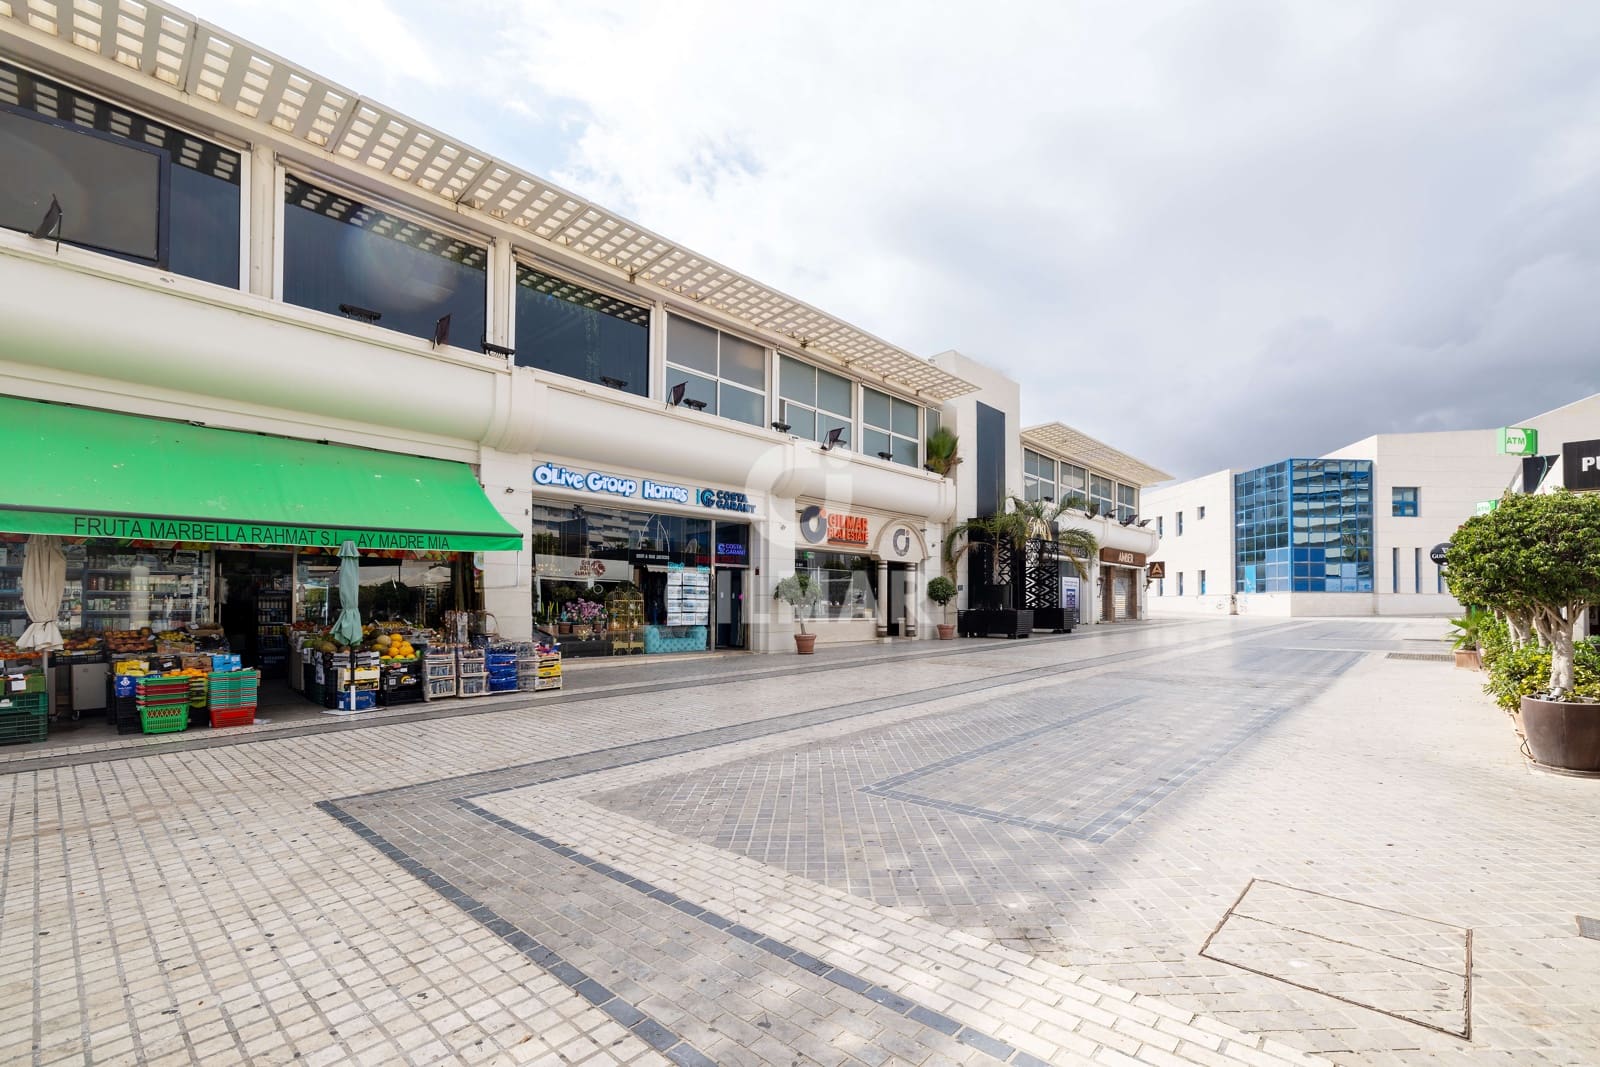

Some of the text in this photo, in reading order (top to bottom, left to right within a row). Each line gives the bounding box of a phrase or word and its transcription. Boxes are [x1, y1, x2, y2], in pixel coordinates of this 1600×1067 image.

[1506, 437, 1525, 445] ATM
[585, 472, 637, 497] Group
[642, 480, 688, 503] Homes
[716, 490, 748, 503] COSTA
[715, 500, 756, 513] GARANT
[827, 513, 868, 531] GILMAR
[74, 517, 143, 537] FRUTA
[151, 521, 247, 542] MARBELLA
[251, 527, 317, 546] RAHMAT
[358, 533, 375, 548] AY
[379, 534, 424, 549] MADRE
[428, 536, 450, 550] MIA
[827, 527, 869, 542] REAL ESTATE
